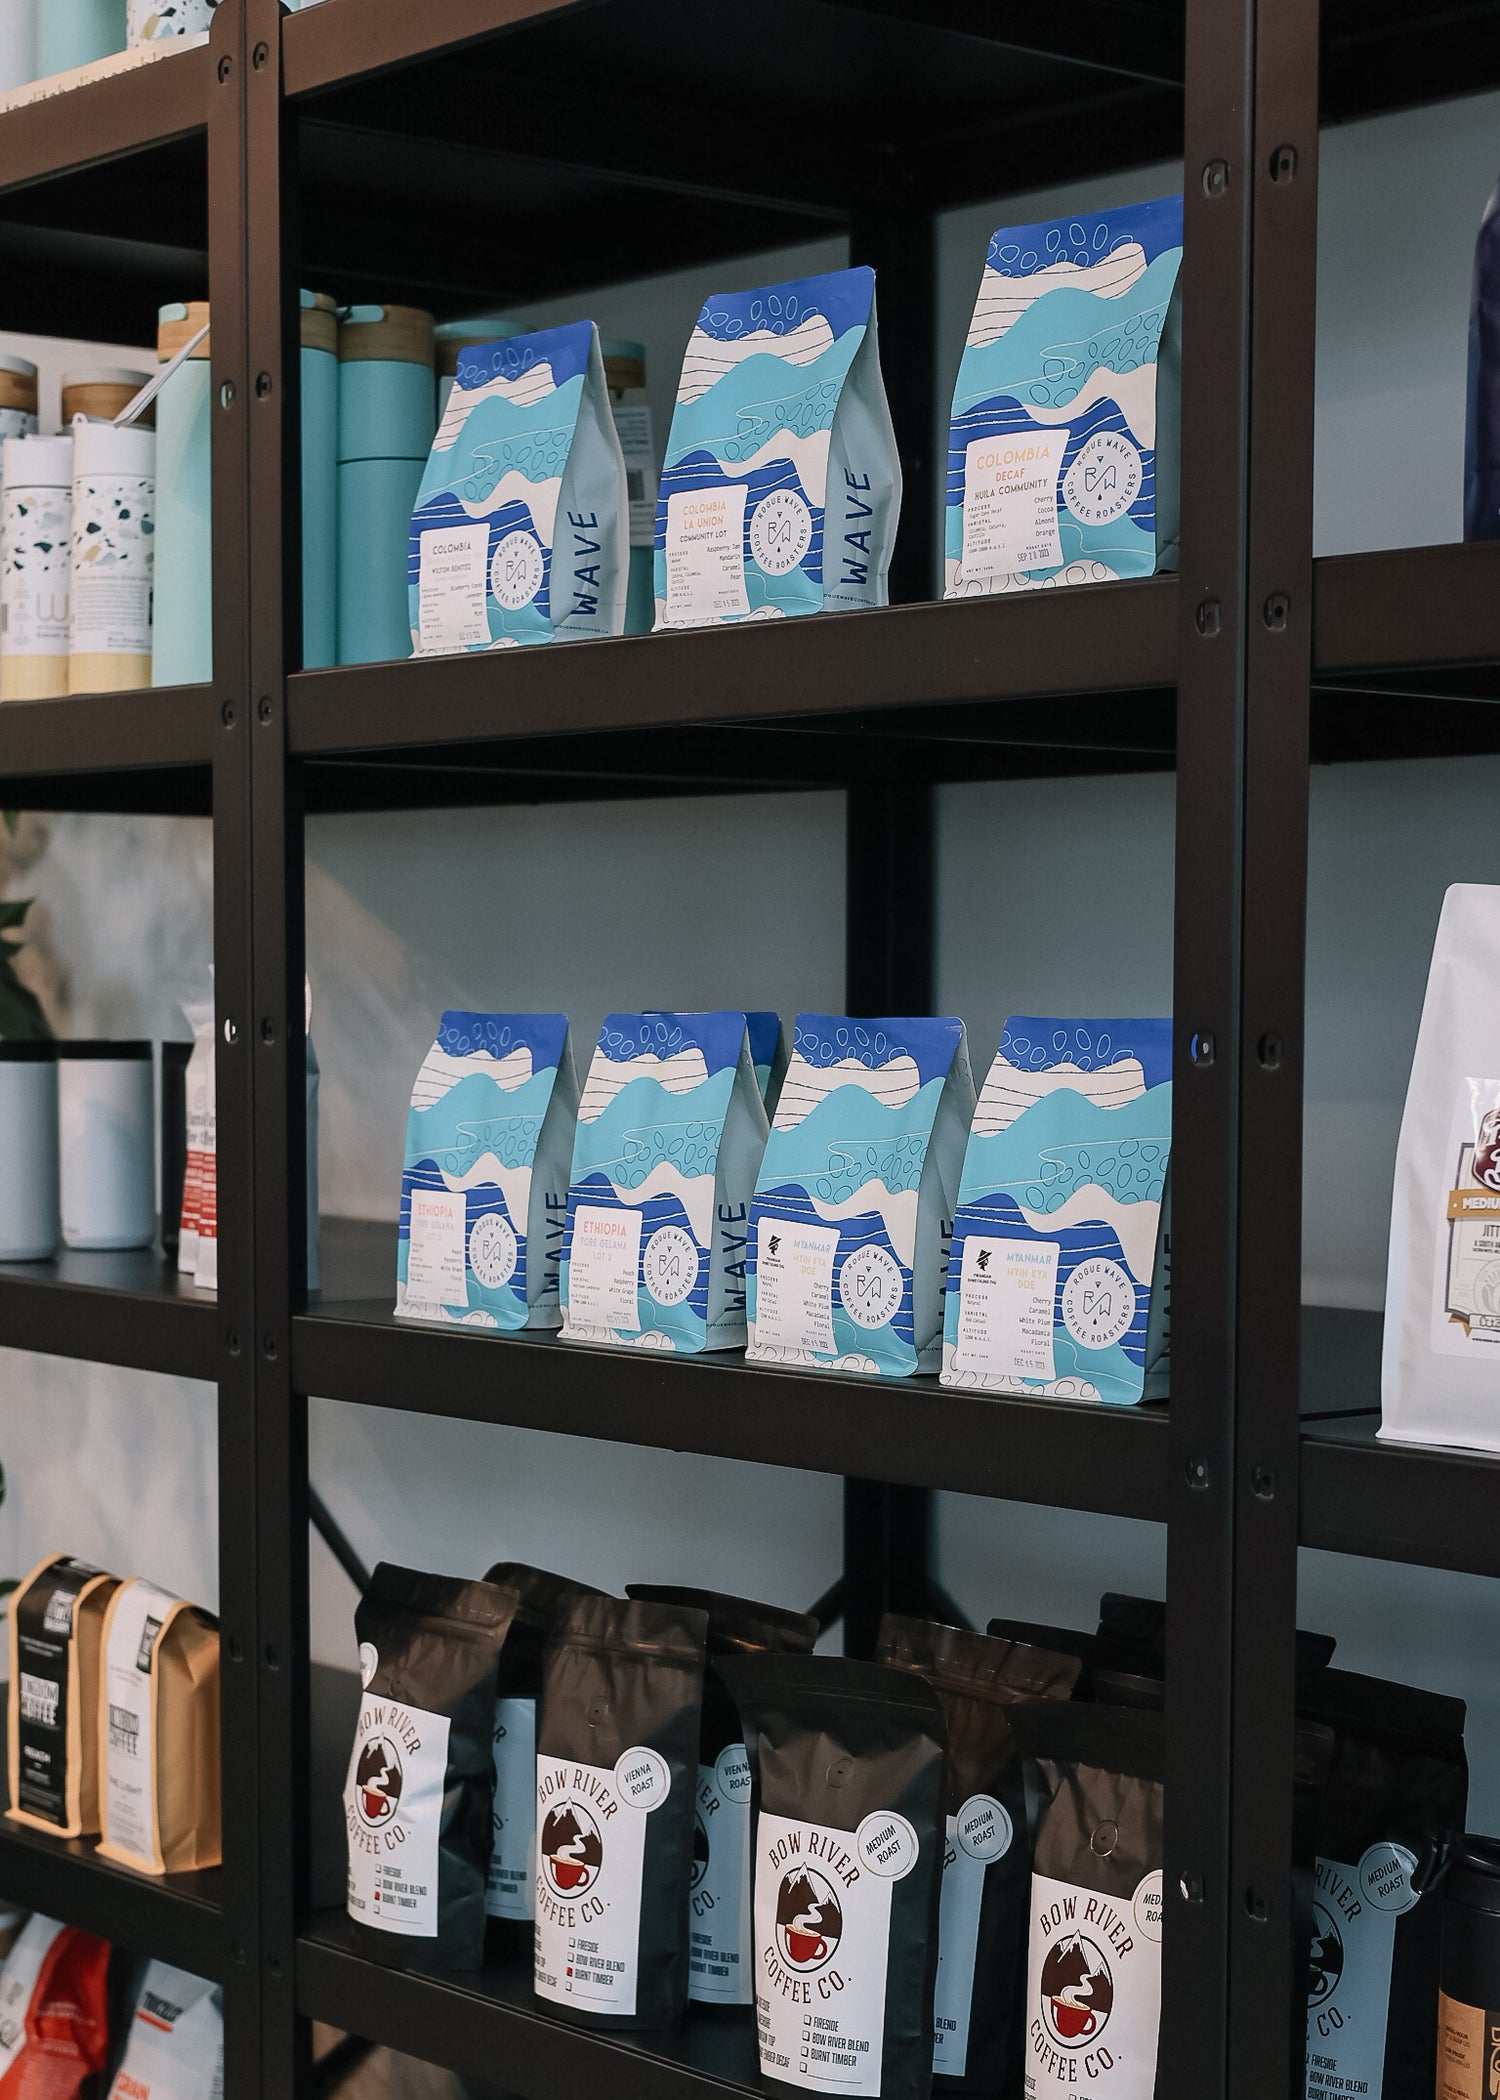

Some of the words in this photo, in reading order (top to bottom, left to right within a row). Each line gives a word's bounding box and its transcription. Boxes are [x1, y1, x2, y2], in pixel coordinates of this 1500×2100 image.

[976, 447, 1050, 470] COLOMBIA
[1077, 438, 1102, 467] ROGUE
[1106, 438, 1131, 460] WAVE
[996, 468, 1026, 482] DECAF
[974, 488, 995, 500] HUILA
[998, 478, 1049, 496] COMMUNITY
[1067, 482, 1091, 519] COFFEE
[1096, 472, 1137, 519] ROASTERS
[683, 500, 727, 515] COLOMBIA
[758, 495, 781, 519] ROGUE
[784, 495, 803, 515] WAVE
[1034, 496, 1053, 504] Cherry
[1037, 506, 1054, 514] Cocoa
[684, 520, 694, 530] LA
[698, 516, 724, 529] UNION
[840, 467, 873, 584] WAVE
[1035, 517, 1055, 526] Almond
[680, 531, 714, 543] COMMUNITY
[715, 529, 727, 539] LOT
[1035, 528, 1055, 537] Orange
[432, 541, 472, 555] COLOMBIA
[707, 545, 730, 553] Raspberry
[754, 533, 772, 569] COFFEE
[776, 527, 808, 569] ROASTERS
[567, 511, 600, 615] WAVE
[1017, 553, 1027, 562] SEP
[722, 563, 741, 572] Caramel
[512, 566, 540, 605] ROASTERS
[418, 1203, 454, 1218] ETHIOPIA
[1463, 1197, 1500, 1210] MEDIU
[583, 1220, 628, 1237] ETHIOPIA
[1482, 1225, 1500, 1238] JITT
[651, 1230, 672, 1252] ROGUE
[673, 1231, 691, 1253] WAVE
[793, 1239, 831, 1254] MYANMAR
[719, 1202, 747, 1312] WAVE
[873, 1252, 894, 1273] WAVE
[1007, 1252, 1052, 1266] MYANMAR
[647, 1263, 662, 1298] COFFEE
[664, 1265, 694, 1300] ROASTERS
[1007, 1267, 1029, 1278] MYIN
[1031, 1269, 1048, 1280] KYA
[1073, 1264, 1101, 1286] ROGUE
[1104, 1265, 1126, 1289] WAVE
[813, 1282, 830, 1292] Cherry
[1017, 1280, 1036, 1290] DOE
[811, 1292, 829, 1301] Caramel
[843, 1282, 863, 1320] COFFEE
[866, 1286, 898, 1324] ROASTERS
[965, 1293, 989, 1301] PROCESS
[1032, 1297, 1051, 1306] Cherry
[806, 1311, 830, 1320] Macadamia
[1029, 1306, 1051, 1315] Caramel
[814, 1321, 830, 1329] Floral
[1019, 1317, 1035, 1325] White
[1037, 1318, 1051, 1326] Plum
[1066, 1299, 1087, 1339] COFFEE
[1091, 1303, 1130, 1343] ROASTERS
[1022, 1327, 1051, 1337] Macadamia
[1031, 1338, 1051, 1347] Floral
[1014, 1357, 1024, 1367] DEC
[391, 1706, 422, 1756] RIVER
[624, 1763, 652, 1784] VIENNA
[724, 1761, 751, 1776] VIENN
[631, 1776, 655, 1796] ROAST
[729, 1776, 752, 1790] ROAS
[538, 1768, 567, 1804] BOW
[573, 1769, 619, 1821] RIVER
[963, 1809, 994, 1835] MEDIUM
[865, 1824, 897, 1856] MEDIUM
[972, 1826, 997, 1848] ROAST
[768, 1830, 802, 1870] BOW
[808, 1831, 861, 1889] RIVER
[877, 1840, 902, 1866] ROAST
[1367, 1858, 1402, 1887] MEDIUM
[1314, 1863, 1362, 1923] RIVER
[1377, 1874, 1405, 1898] ROAST
[536, 1874, 576, 1928] COFFEE
[1142, 1892, 1162, 1906] MED
[1145, 1909, 1162, 1923] ROA
[1039, 1896, 1078, 1937] BOW
[1083, 1897, 1135, 1960] RIVER
[589, 1955, 604, 1969] RIVER
[605, 1958, 626, 1974] BLEND
[574, 1967, 592, 1981] BURNT
[592, 1970, 614, 1987] TIMBER
[763, 1946, 812, 2004] COFFEE
[813, 2016, 840, 2033] FIRESIDE
[935, 2016, 957, 2032] BLEND
[811, 2032, 828, 2047] BOW
[827, 2035, 847, 2050] RIVER
[847, 2038, 870, 2053] BLEND
[1030, 2019, 1078, 2083] COFFEE
[810, 2046, 831, 2063] BURNT
[831, 2050, 858, 2068] TIMBER
[1311, 2053, 1337, 2071] FIRESIDE
[1309, 2070, 1325, 2085] BOW
[1325, 2074, 1344, 2090] RIVER
[1345, 2079, 1369, 2094] BLEND
[1308, 2086, 1328, 2100] BURNT
